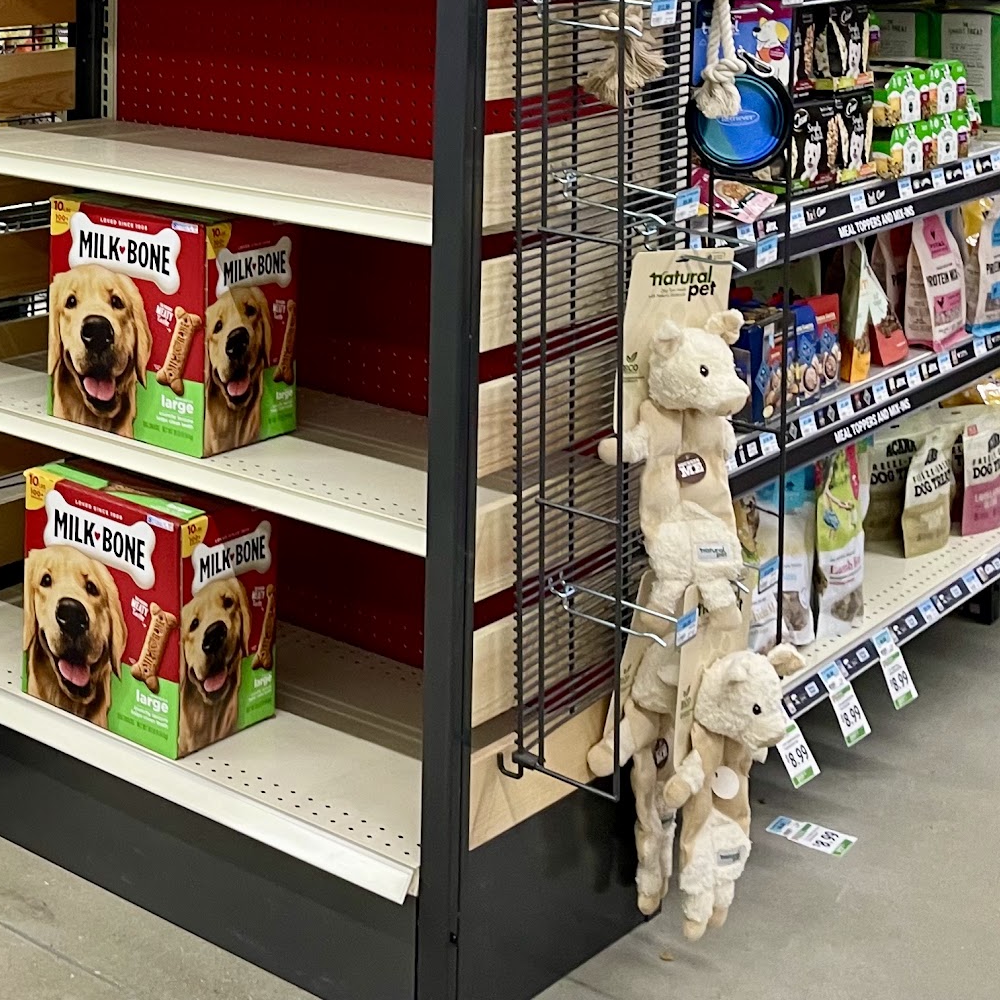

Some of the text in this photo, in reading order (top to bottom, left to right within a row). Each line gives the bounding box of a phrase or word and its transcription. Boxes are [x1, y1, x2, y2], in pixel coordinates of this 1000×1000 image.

[53, 200, 64, 212] 10
[838, 224, 858, 239] MEAL
[854, 215, 882, 234] TOPPERS
[879, 210, 895, 226] AND
[79, 229, 171, 277] MILK BONE
[223, 250, 287, 287] MILK BONE
[650, 265, 713, 287] natural
[687, 280, 717, 302] pet
[161, 393, 195, 415] large
[833, 427, 853, 444] MEAL
[850, 413, 879, 436] TOPPERS
[876, 407, 890, 424] AND
[29, 474, 39, 487] 10
[870, 470, 895, 486] DOG
[973, 463, 993, 480] DOG
[54, 508, 146, 571] MILK BONE
[199, 535, 266, 583] MILK BONE
[135, 688, 169, 713] large
